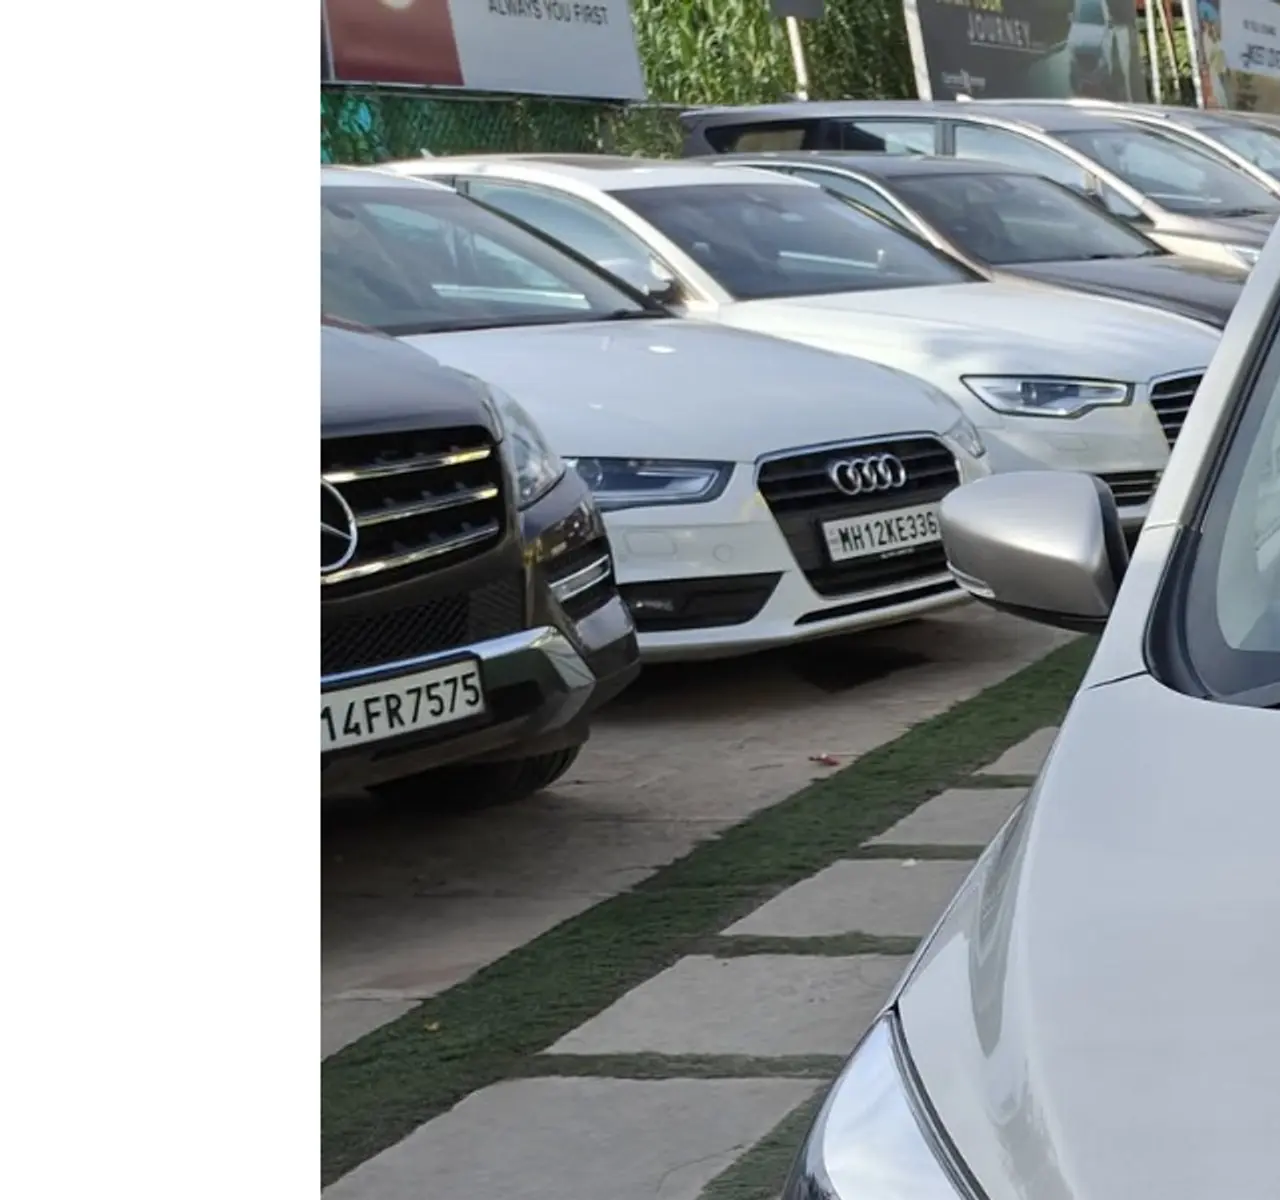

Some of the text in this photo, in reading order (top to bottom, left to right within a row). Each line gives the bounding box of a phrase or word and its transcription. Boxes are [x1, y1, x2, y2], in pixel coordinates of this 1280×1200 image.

[544, 0, 571, 22] YOU
[573, 3, 609, 25] FIRST
[967, 11, 1032, 48] JOURNEY
[321, 672, 480, 741] 14FR7575
